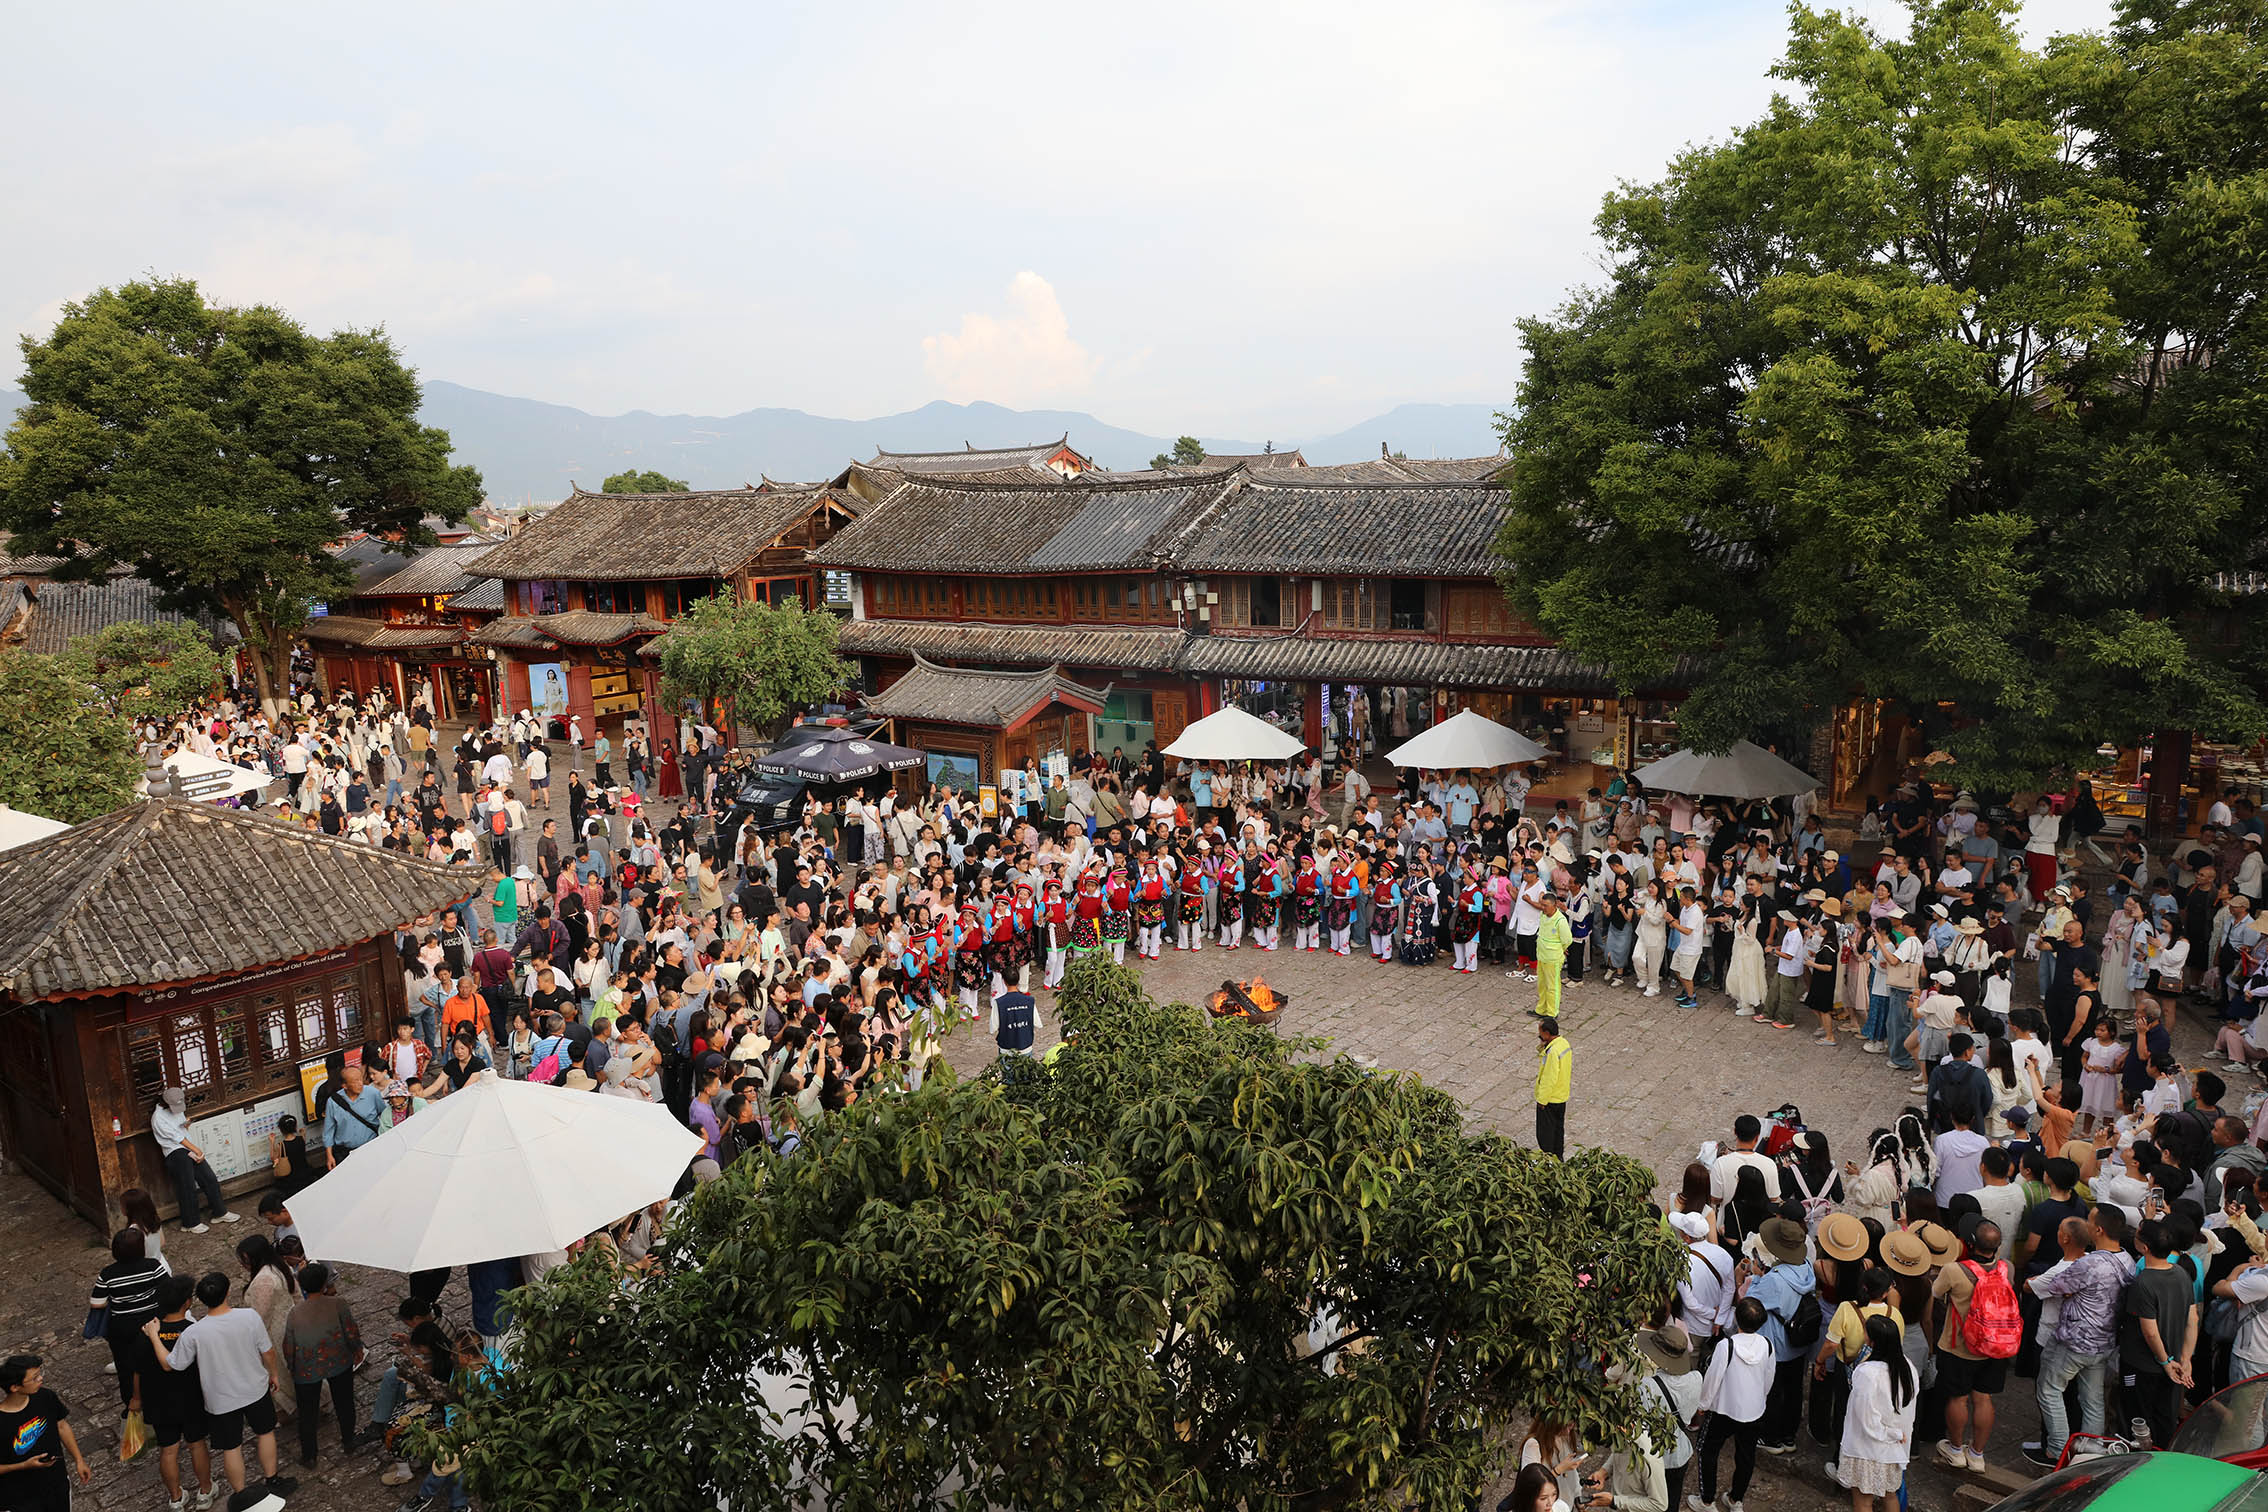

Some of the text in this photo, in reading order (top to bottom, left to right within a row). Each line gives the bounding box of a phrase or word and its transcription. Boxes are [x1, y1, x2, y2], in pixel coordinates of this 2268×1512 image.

[894, 758, 916, 768] POLICE
[762, 764, 780, 774] POLICE
[845, 767, 868, 778] POLICE
[802, 770, 820, 780] POLICE
[191, 979, 241, 994] Comprehensive
[242, 973, 265, 982] Service
[265, 967, 283, 976] Kiosk
[290, 961, 302, 970] Old
[302, 959, 320, 967] Town
[327, 952, 346, 961] Lijiang
